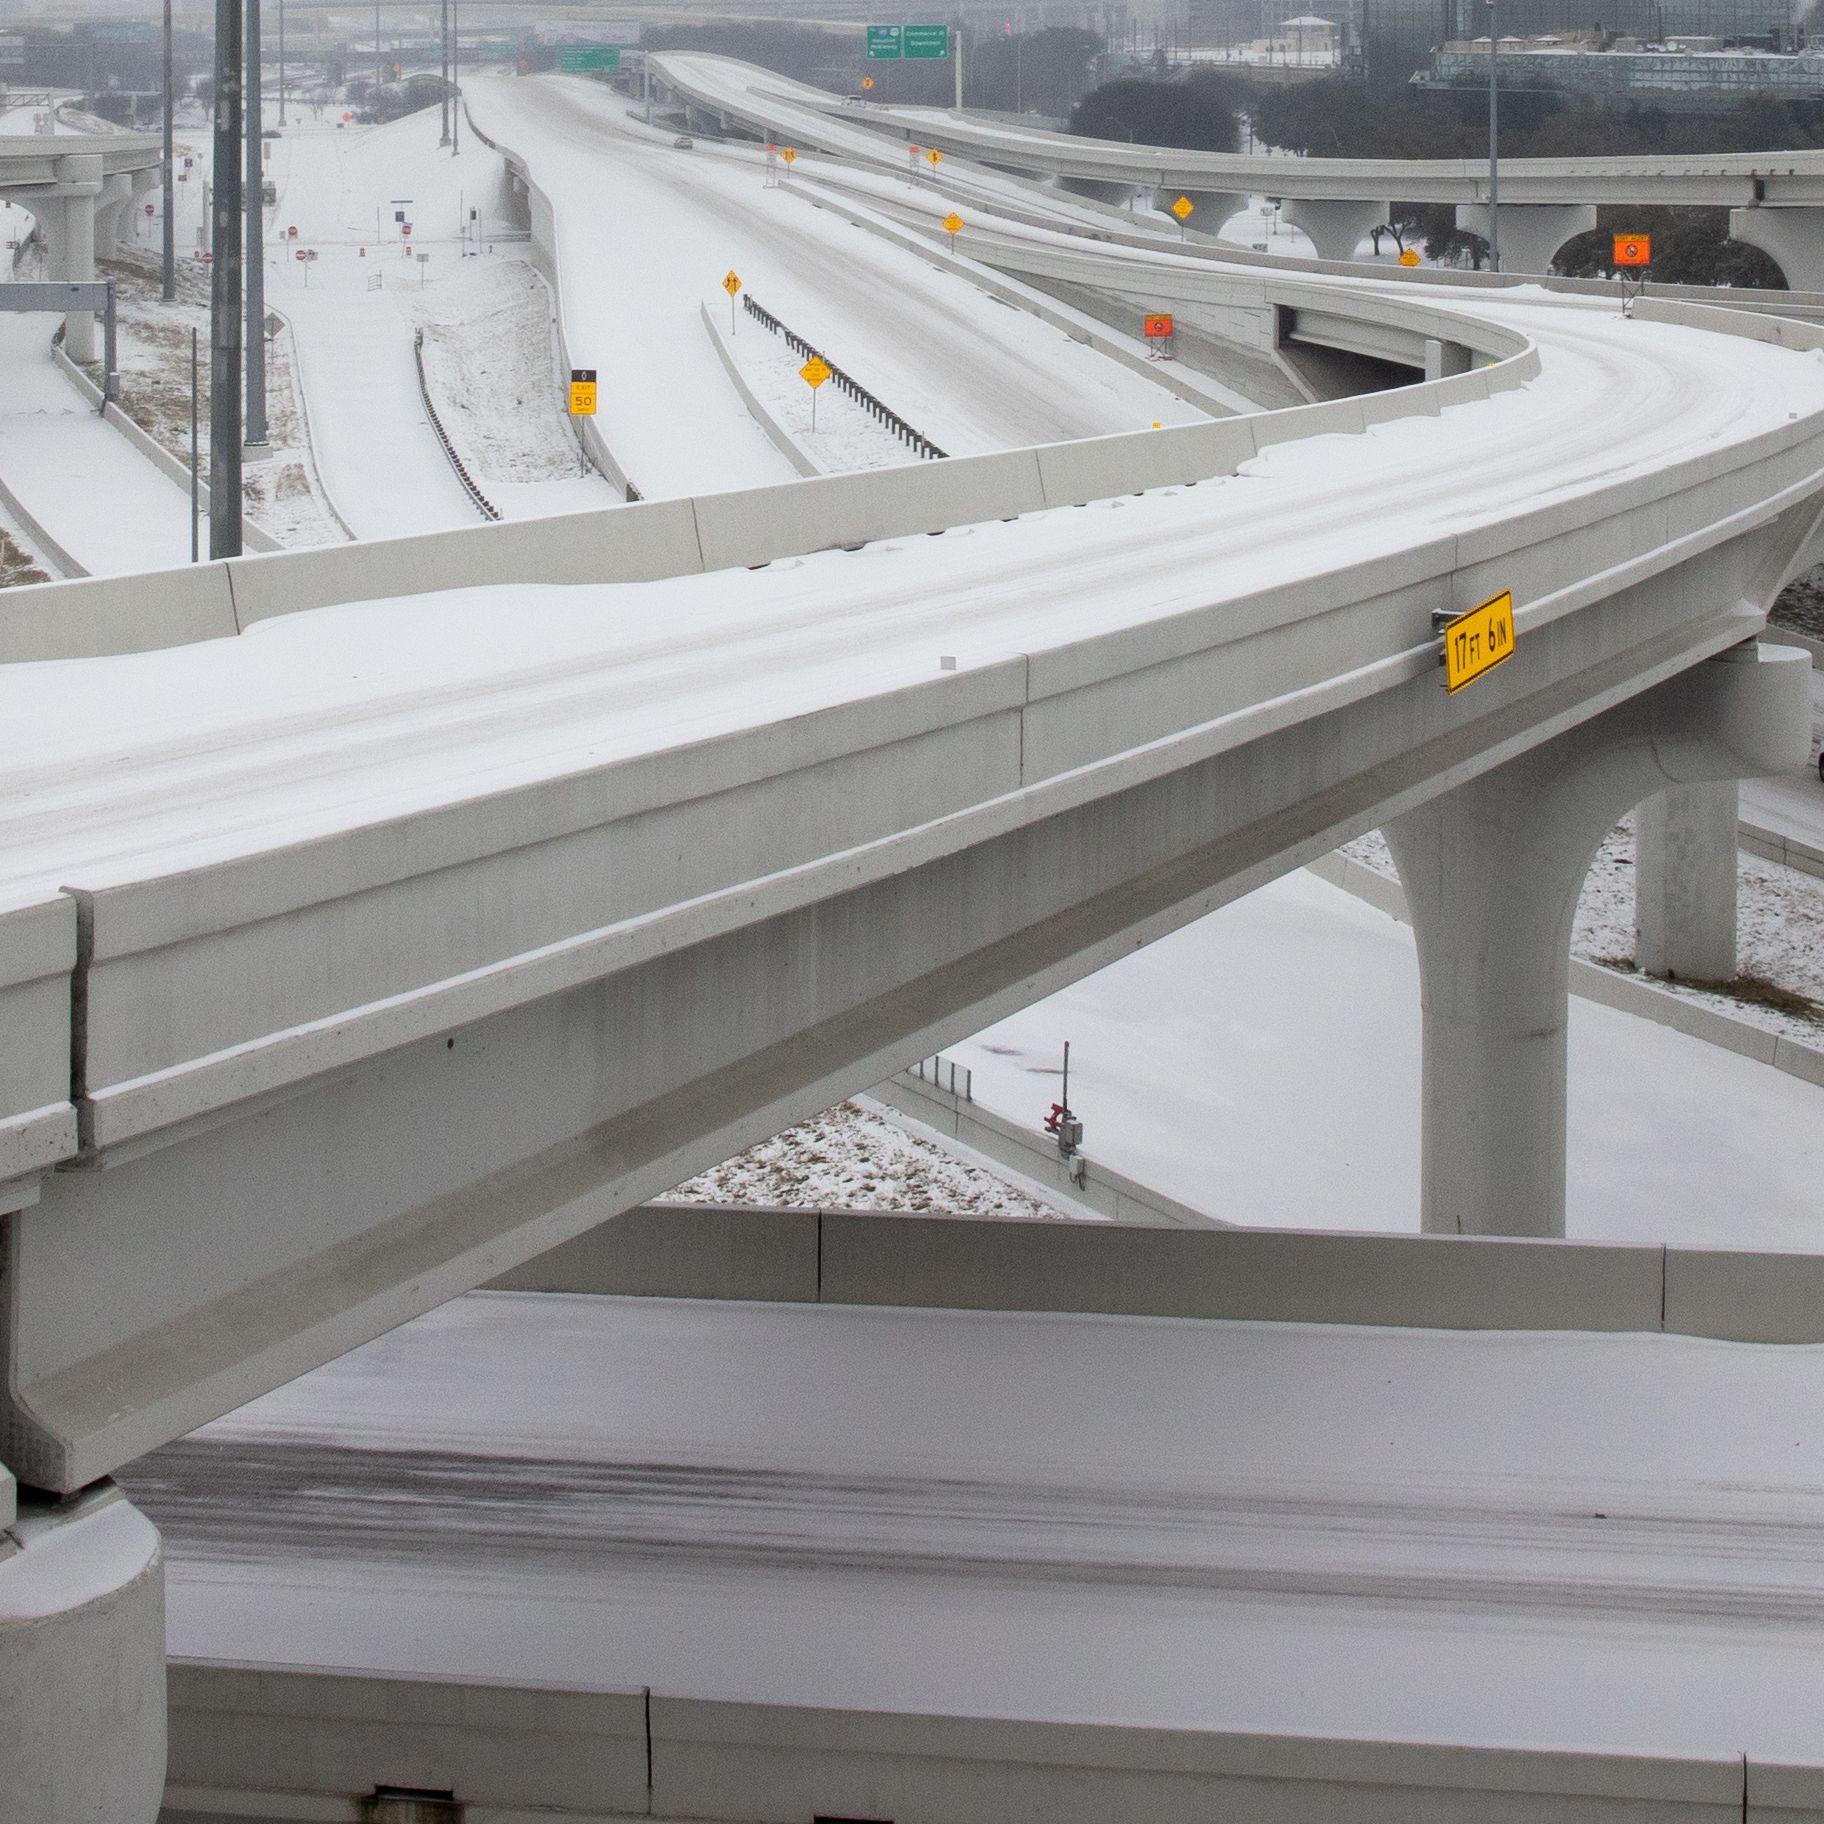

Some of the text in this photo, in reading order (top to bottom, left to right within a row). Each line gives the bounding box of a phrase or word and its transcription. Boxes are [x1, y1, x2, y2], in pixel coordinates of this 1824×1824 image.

[575, 396, 592, 406] 50
[1455, 617, 1507, 673] 17 FT 6 IN
